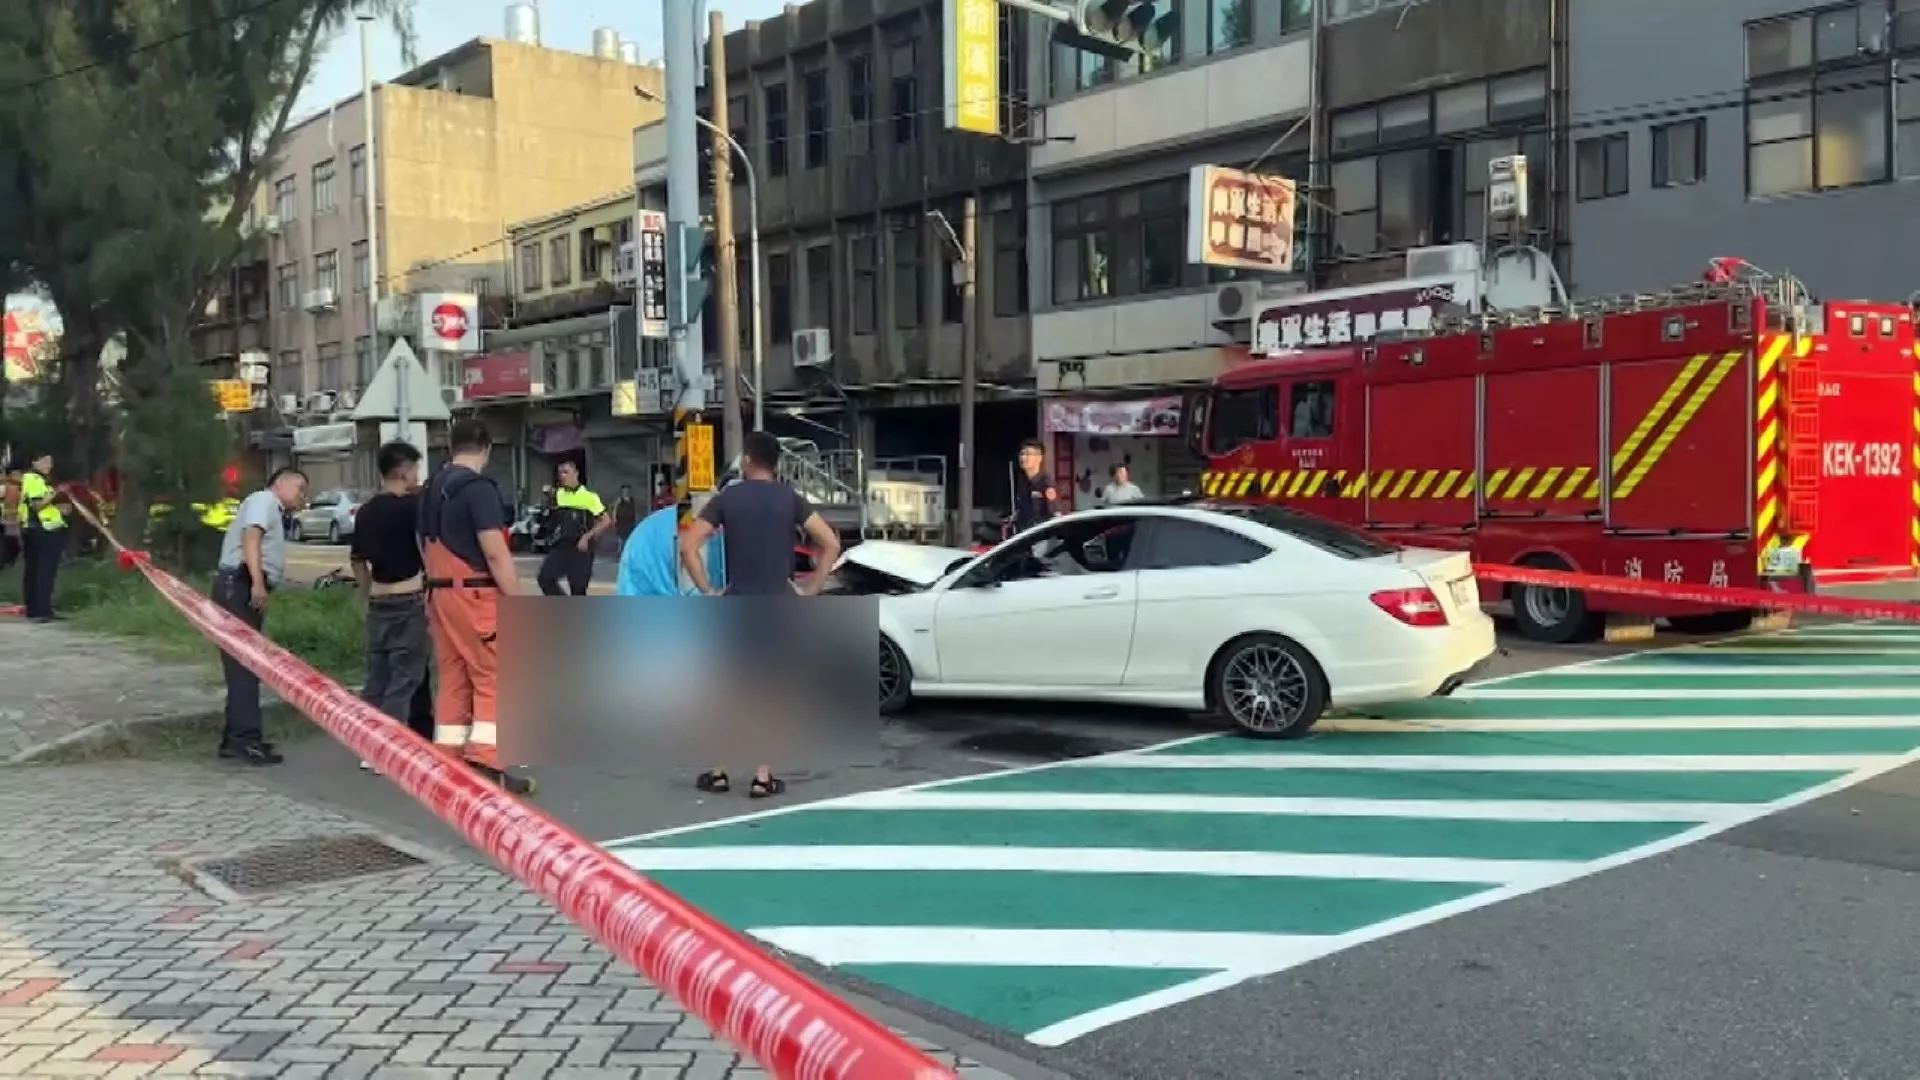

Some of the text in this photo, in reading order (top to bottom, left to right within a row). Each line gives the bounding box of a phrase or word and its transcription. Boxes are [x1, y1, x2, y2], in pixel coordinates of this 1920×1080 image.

[1823, 442, 1902, 476] KEK-1392
[1624, 557, 1729, 588] 消防局
